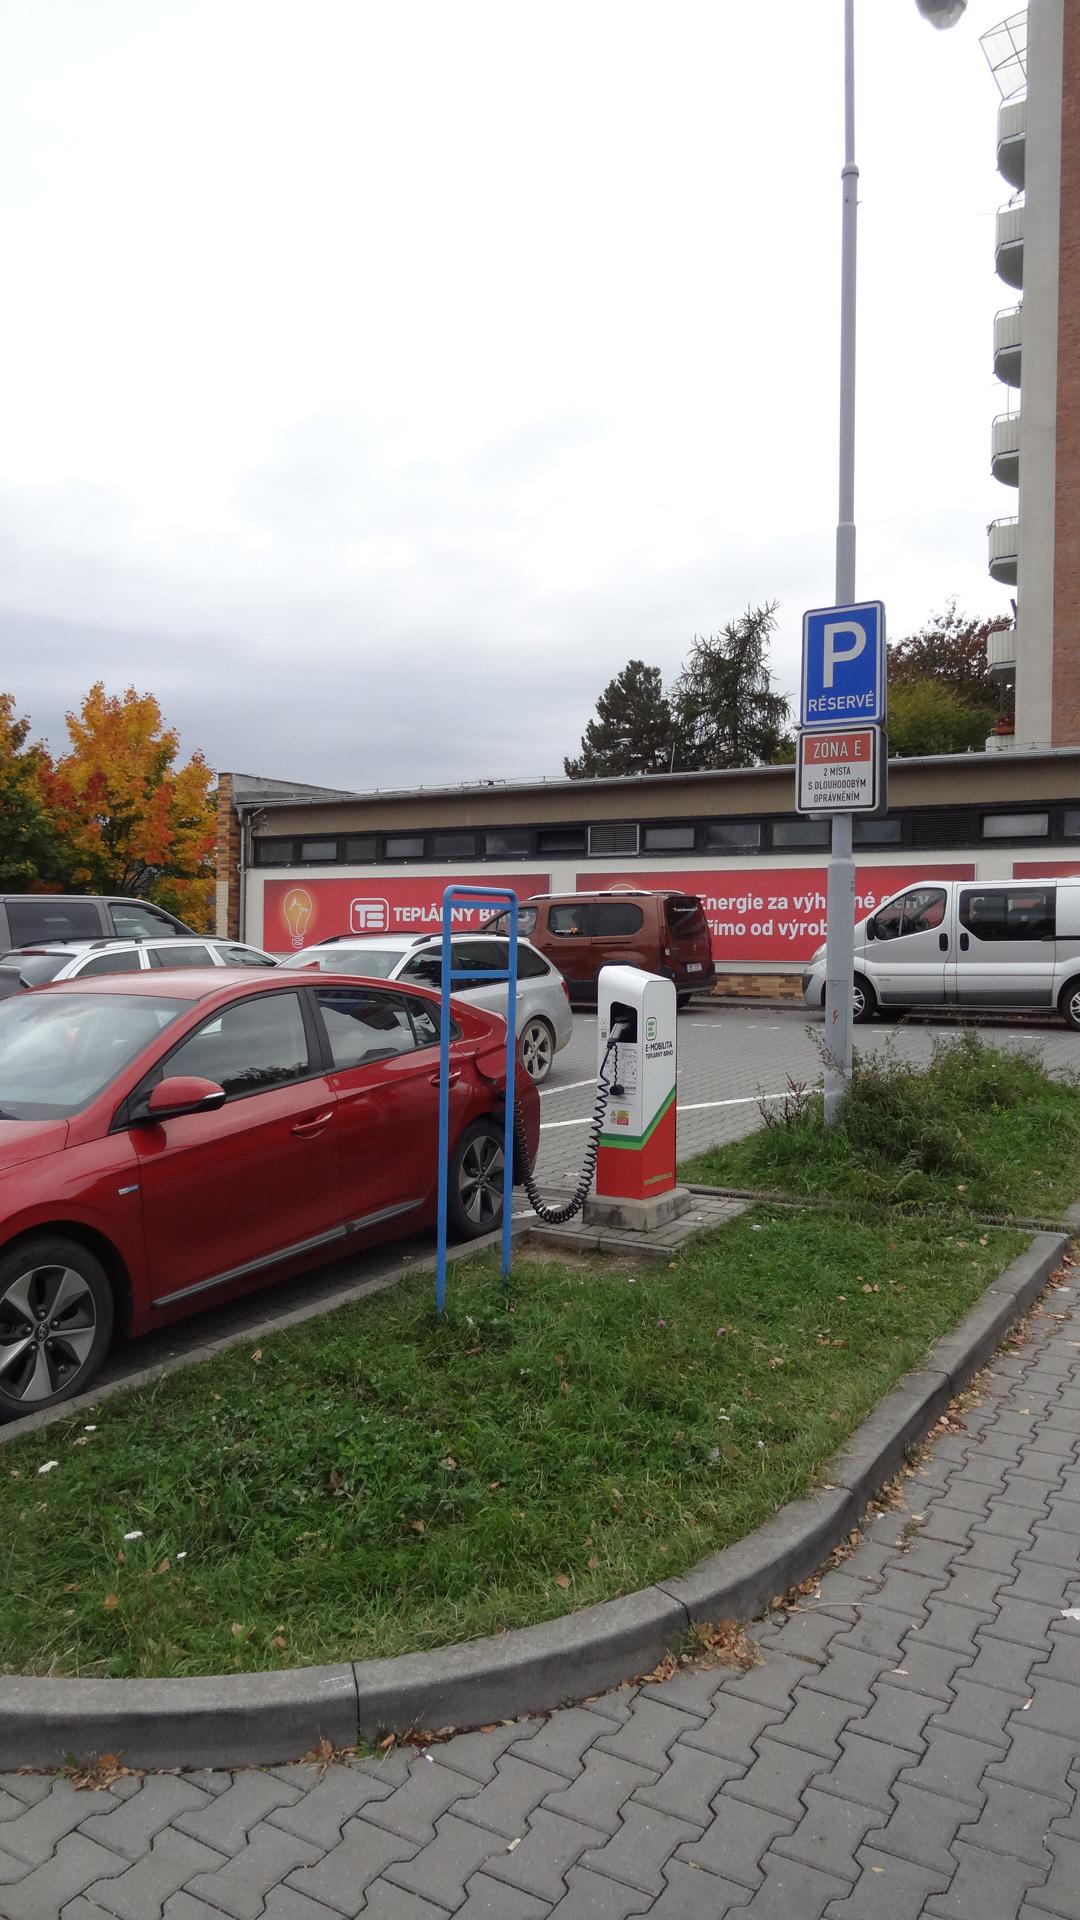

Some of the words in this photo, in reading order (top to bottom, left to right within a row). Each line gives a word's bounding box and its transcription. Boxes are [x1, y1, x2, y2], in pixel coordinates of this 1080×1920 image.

[823, 621, 866, 688] P
[808, 691, 874, 712] RÉSERVÉ
[813, 738, 849, 759] ZÓNA
[854, 739, 862, 757] E
[823, 767, 828, 777] 2
[829, 765, 851, 776] MÍSTA
[807, 781, 813, 791] S
[814, 777, 867, 790] DLOUHODOBÝM
[813, 791, 860, 803] OPRÁVNĚNÍM
[393, 903, 474, 922] TEPLÁNY
[696, 893, 763, 913] Energie
[767, 896, 788, 910] za
[792, 892, 876, 914] výhné
[750, 919, 773, 936] od
